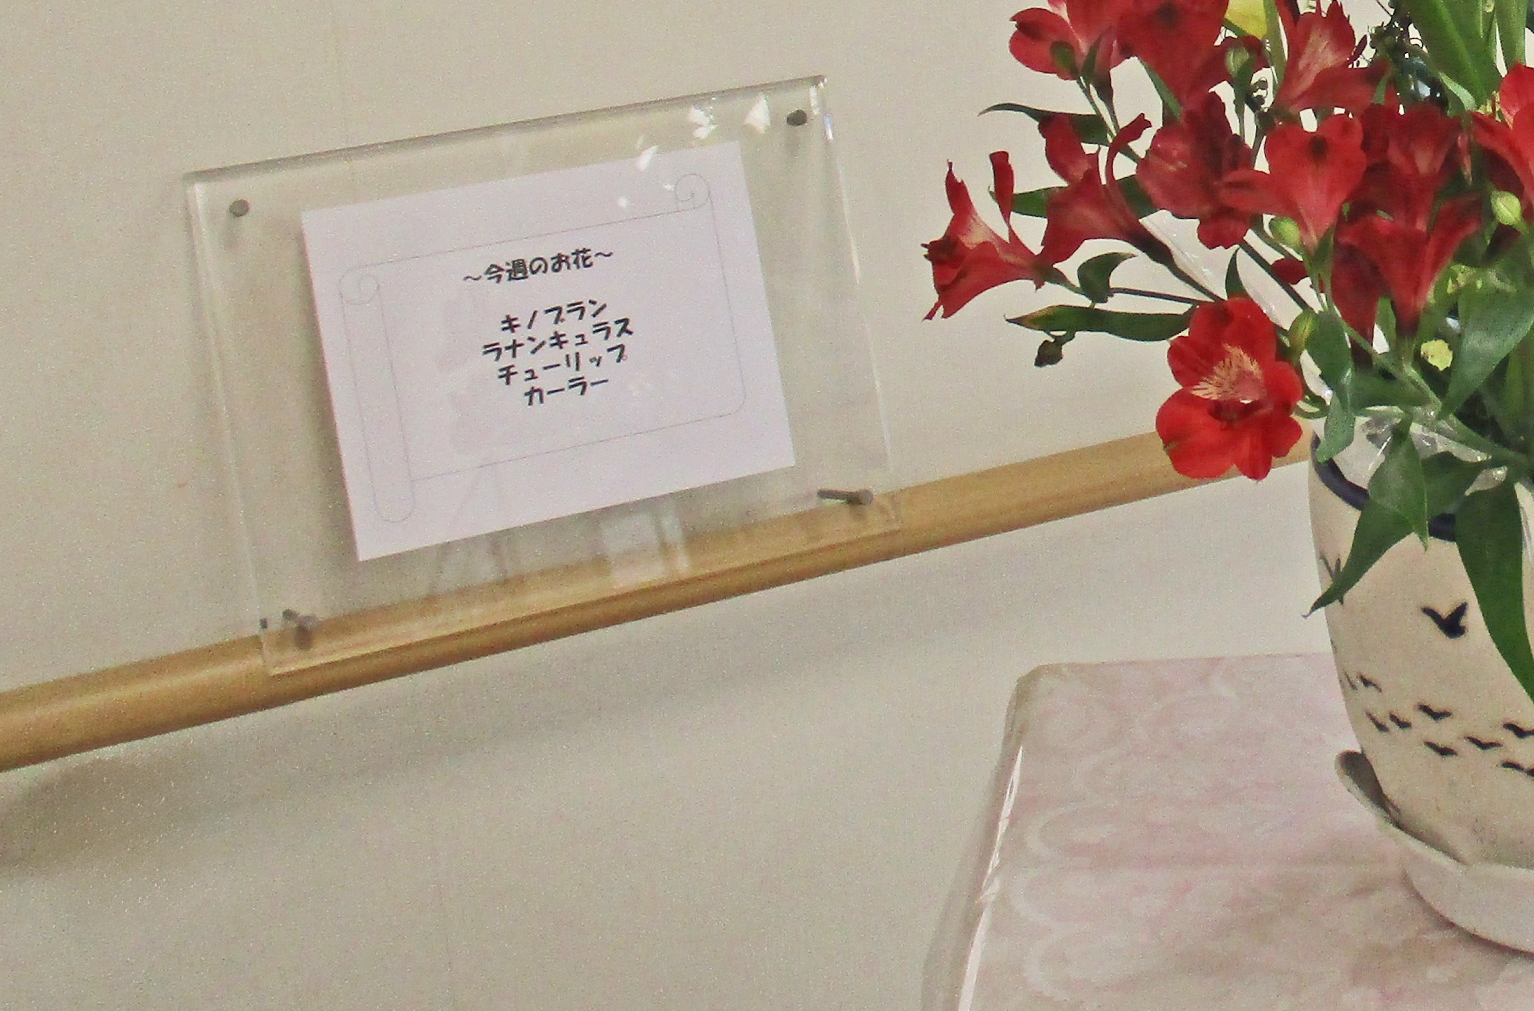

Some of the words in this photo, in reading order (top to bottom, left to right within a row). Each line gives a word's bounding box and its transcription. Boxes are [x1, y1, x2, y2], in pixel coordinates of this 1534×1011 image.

[481, 317, 635, 362] ラナンキュラス
[497, 343, 629, 386] チューリップ
[523, 376, 609, 406] カーラー
